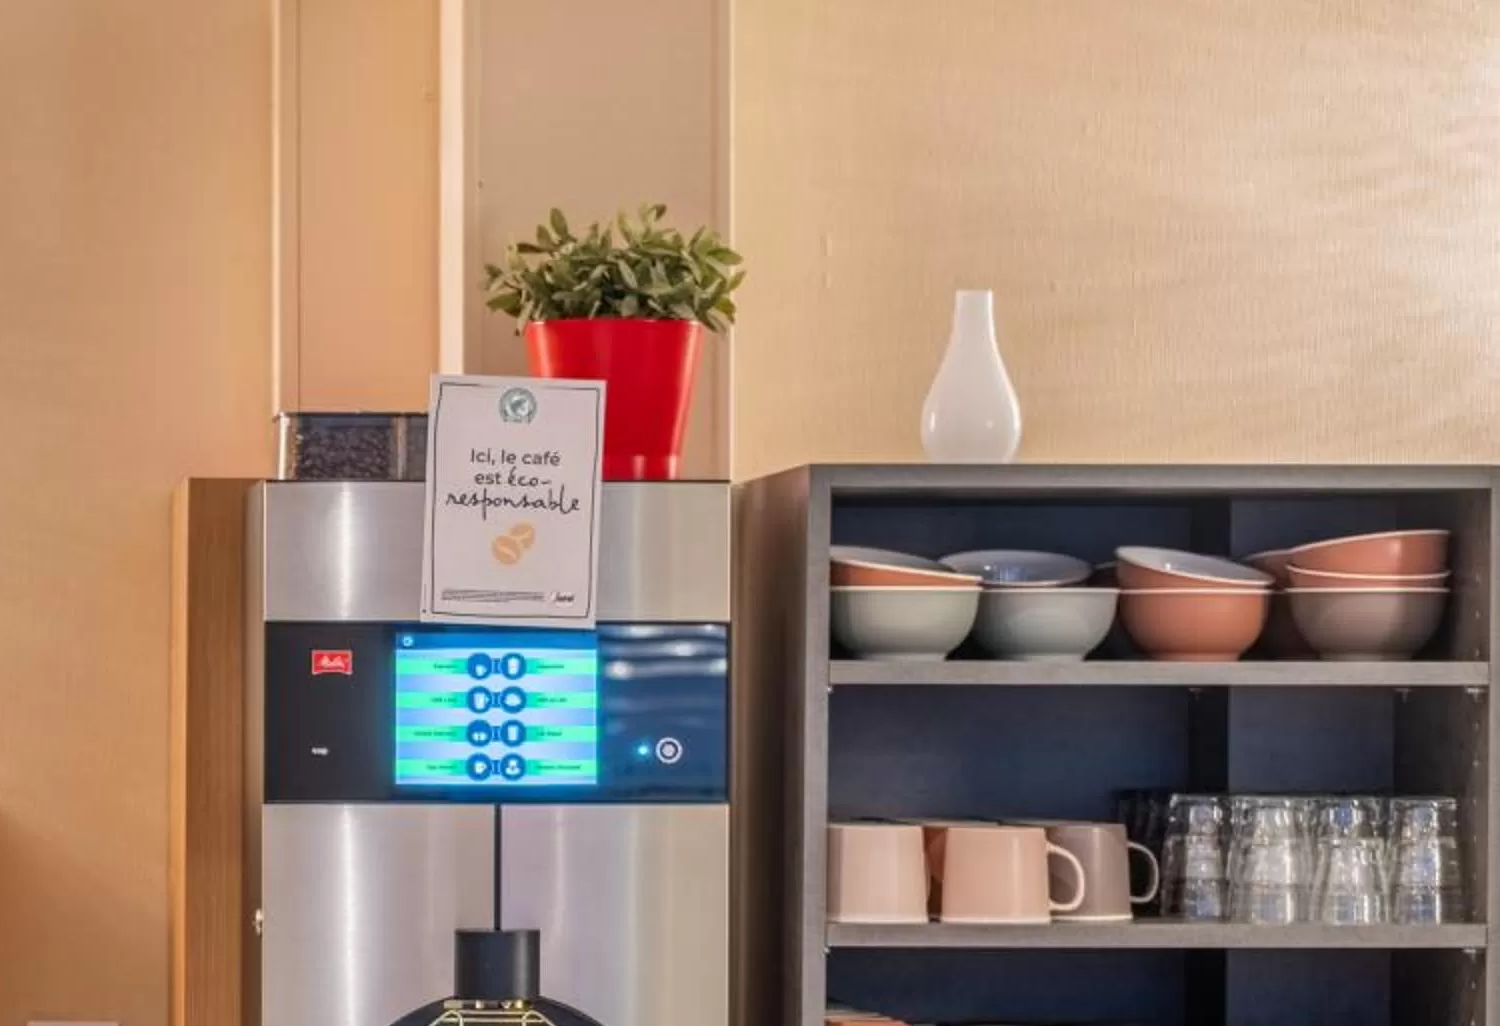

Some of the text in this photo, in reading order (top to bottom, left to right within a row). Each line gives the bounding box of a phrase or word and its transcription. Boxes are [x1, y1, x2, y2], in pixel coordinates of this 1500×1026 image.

[470, 448, 561, 466] Ici, le café
[474, 472, 502, 485] est
[445, 484, 581, 520] responsable
